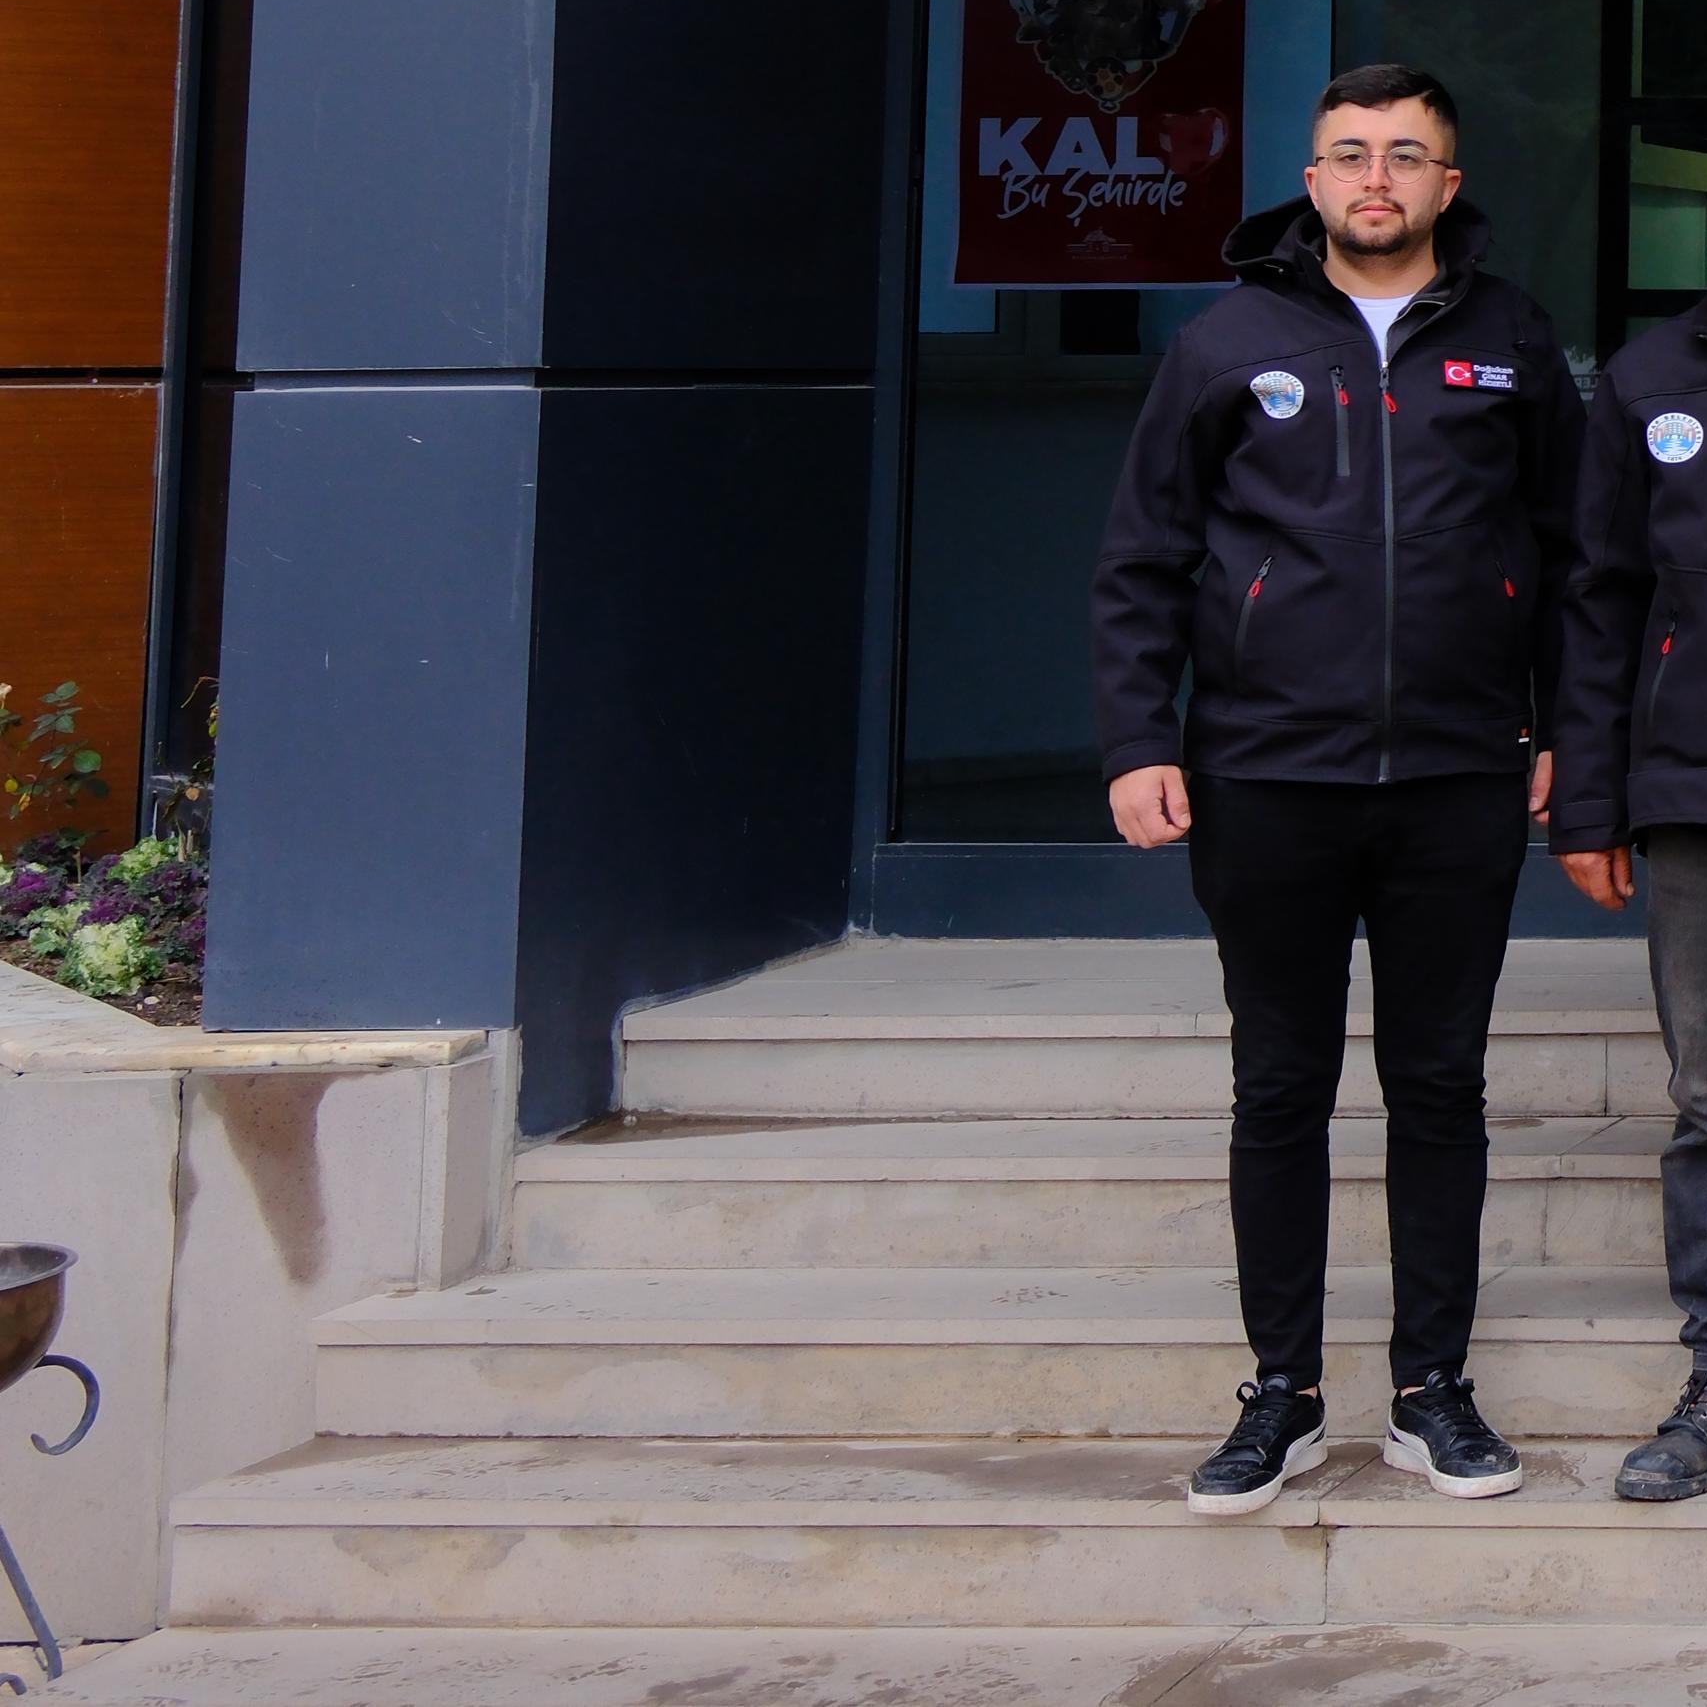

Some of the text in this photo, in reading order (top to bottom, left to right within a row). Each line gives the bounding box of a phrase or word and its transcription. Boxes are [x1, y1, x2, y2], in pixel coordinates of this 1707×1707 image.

[978, 115, 1165, 177] KAL
[996, 167, 1188, 228] Bu Şehirde
